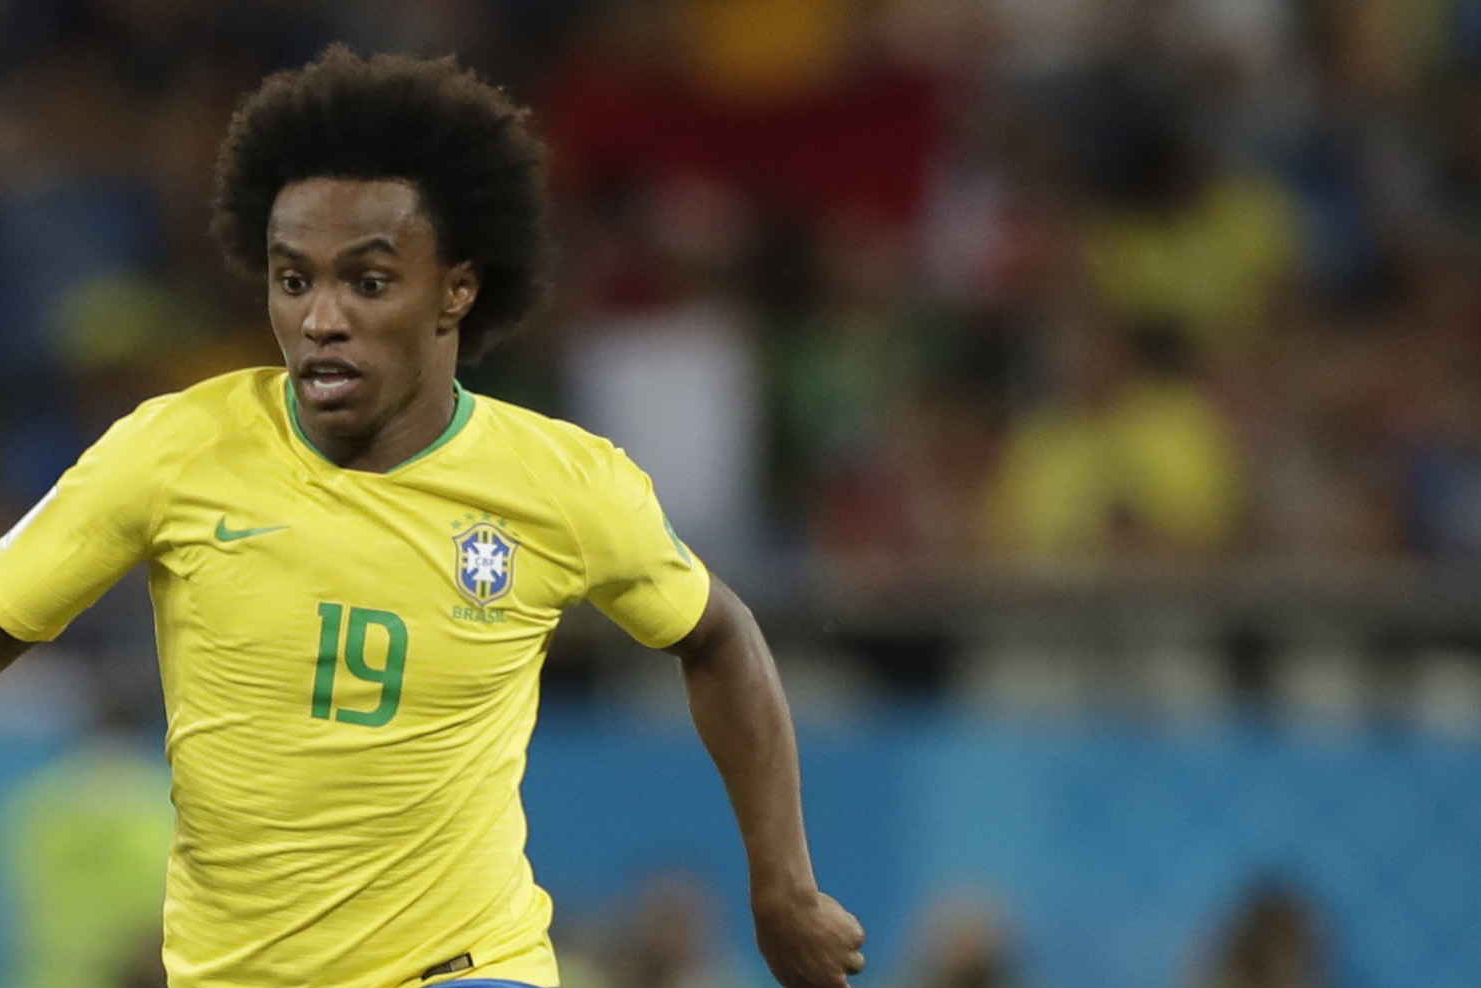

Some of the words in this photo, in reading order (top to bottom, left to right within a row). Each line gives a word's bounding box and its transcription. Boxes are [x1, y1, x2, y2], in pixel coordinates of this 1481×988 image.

[475, 557, 495, 567] CBF
[452, 605, 508, 623] BRASIL
[311, 602, 408, 727] 19
